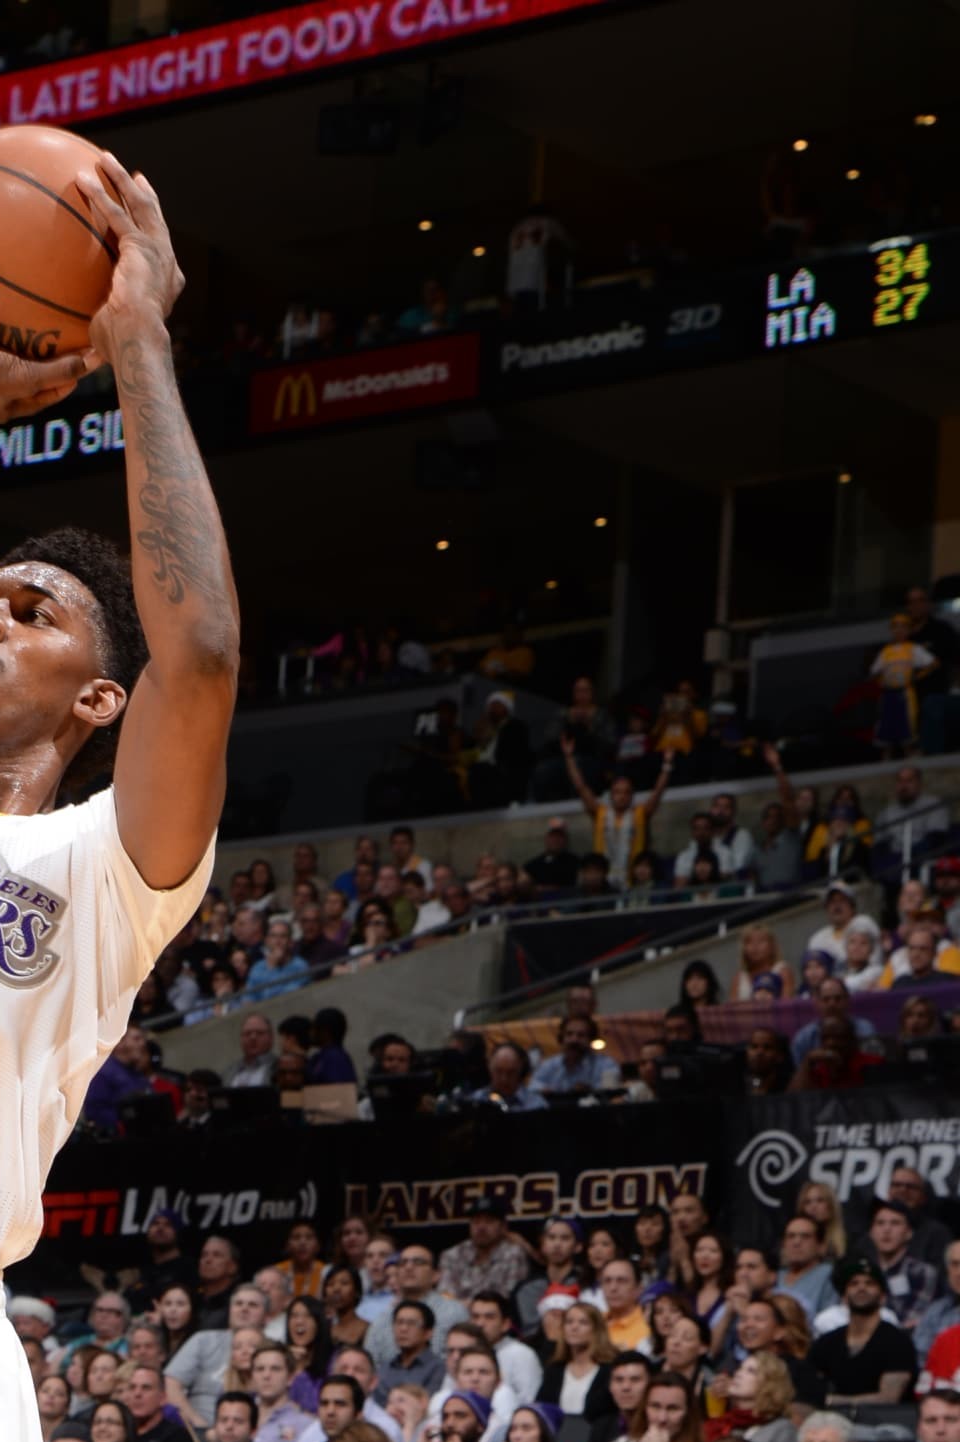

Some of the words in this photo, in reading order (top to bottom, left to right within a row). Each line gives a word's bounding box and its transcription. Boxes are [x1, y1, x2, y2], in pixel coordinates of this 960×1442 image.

[9, 68, 100, 125] LATE
[108, 37, 229, 106] NIGHT
[237, 3, 382, 75] FOODY
[767, 267, 814, 310] LA
[873, 243, 931, 287] 34
[500, 320, 647, 373] Panasonic
[665, 303, 722, 336] 3D
[765, 301, 837, 347] MIA
[872, 282, 929, 327] 27
[321, 361, 451, 404] McDonald's
[813, 1123, 873, 1149] TIME
[195, 1190, 261, 1230] 710
[344, 1162, 709, 1229] LAKERS.COM
